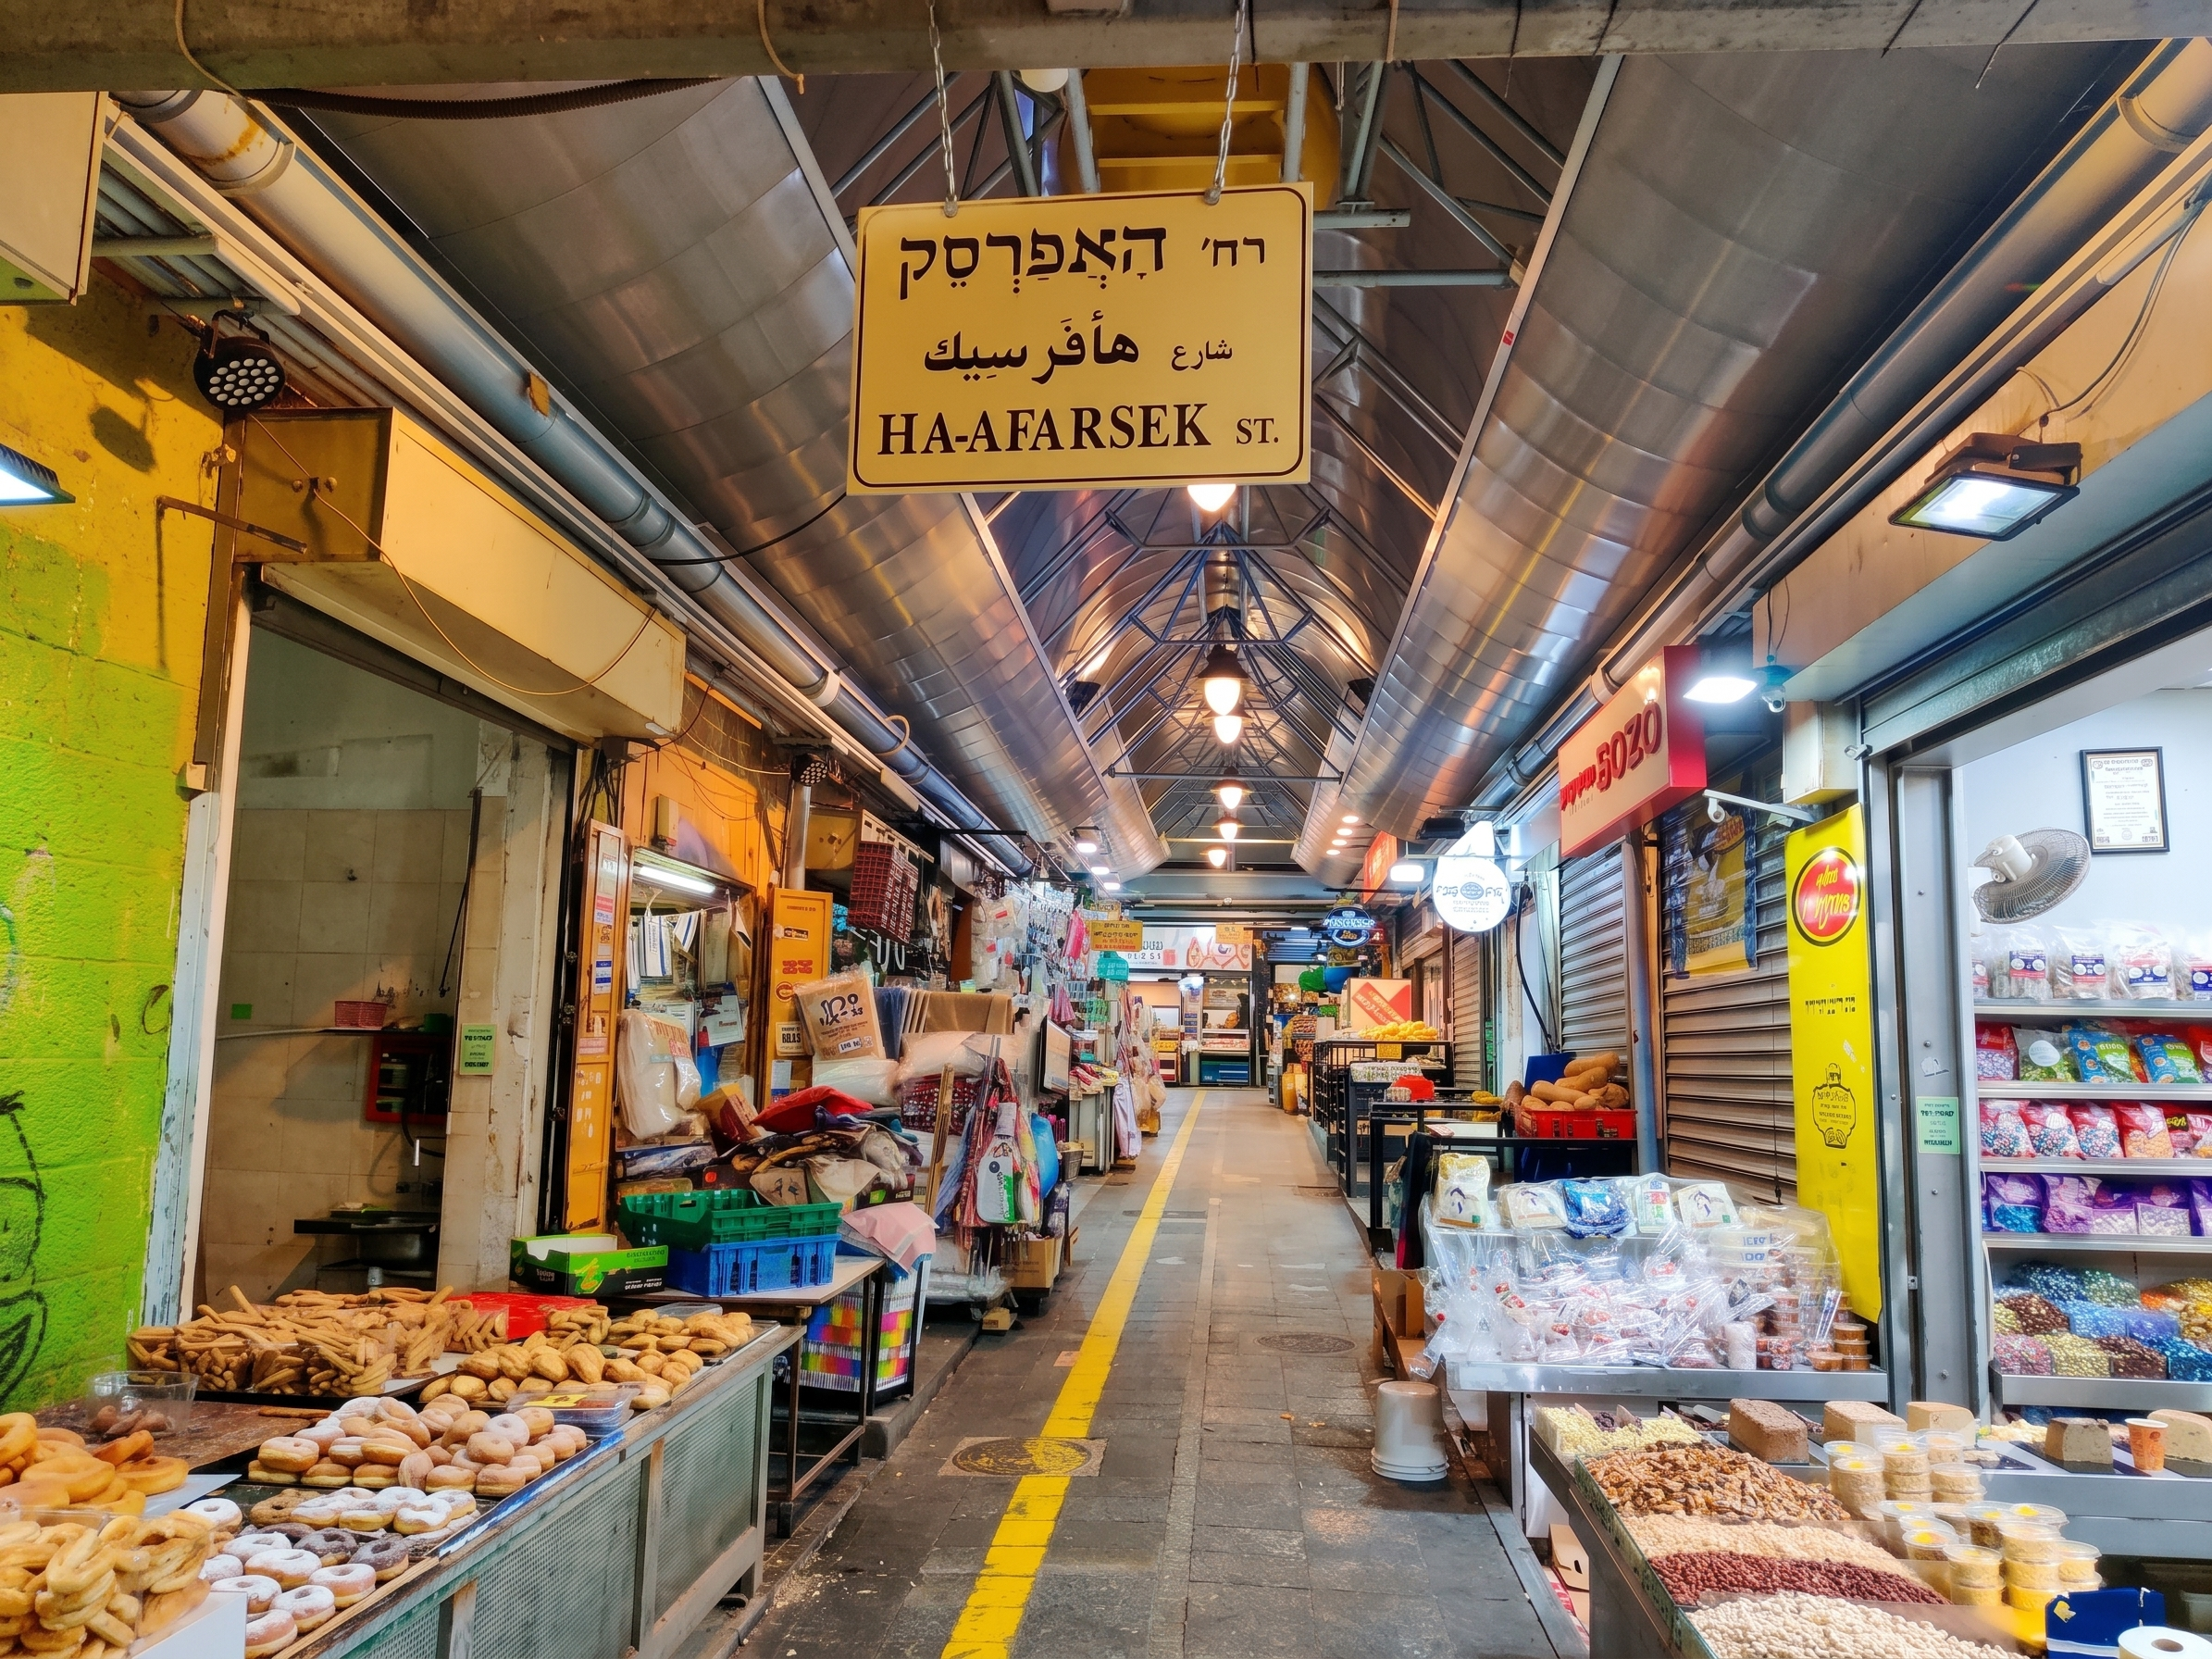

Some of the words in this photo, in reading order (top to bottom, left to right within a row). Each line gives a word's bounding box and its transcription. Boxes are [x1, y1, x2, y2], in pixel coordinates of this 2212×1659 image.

[1171, 339, 1234, 371] شارع
[877, 403, 1212, 455] HA-AFARSEK
[1235, 418, 1279, 445] ST.
